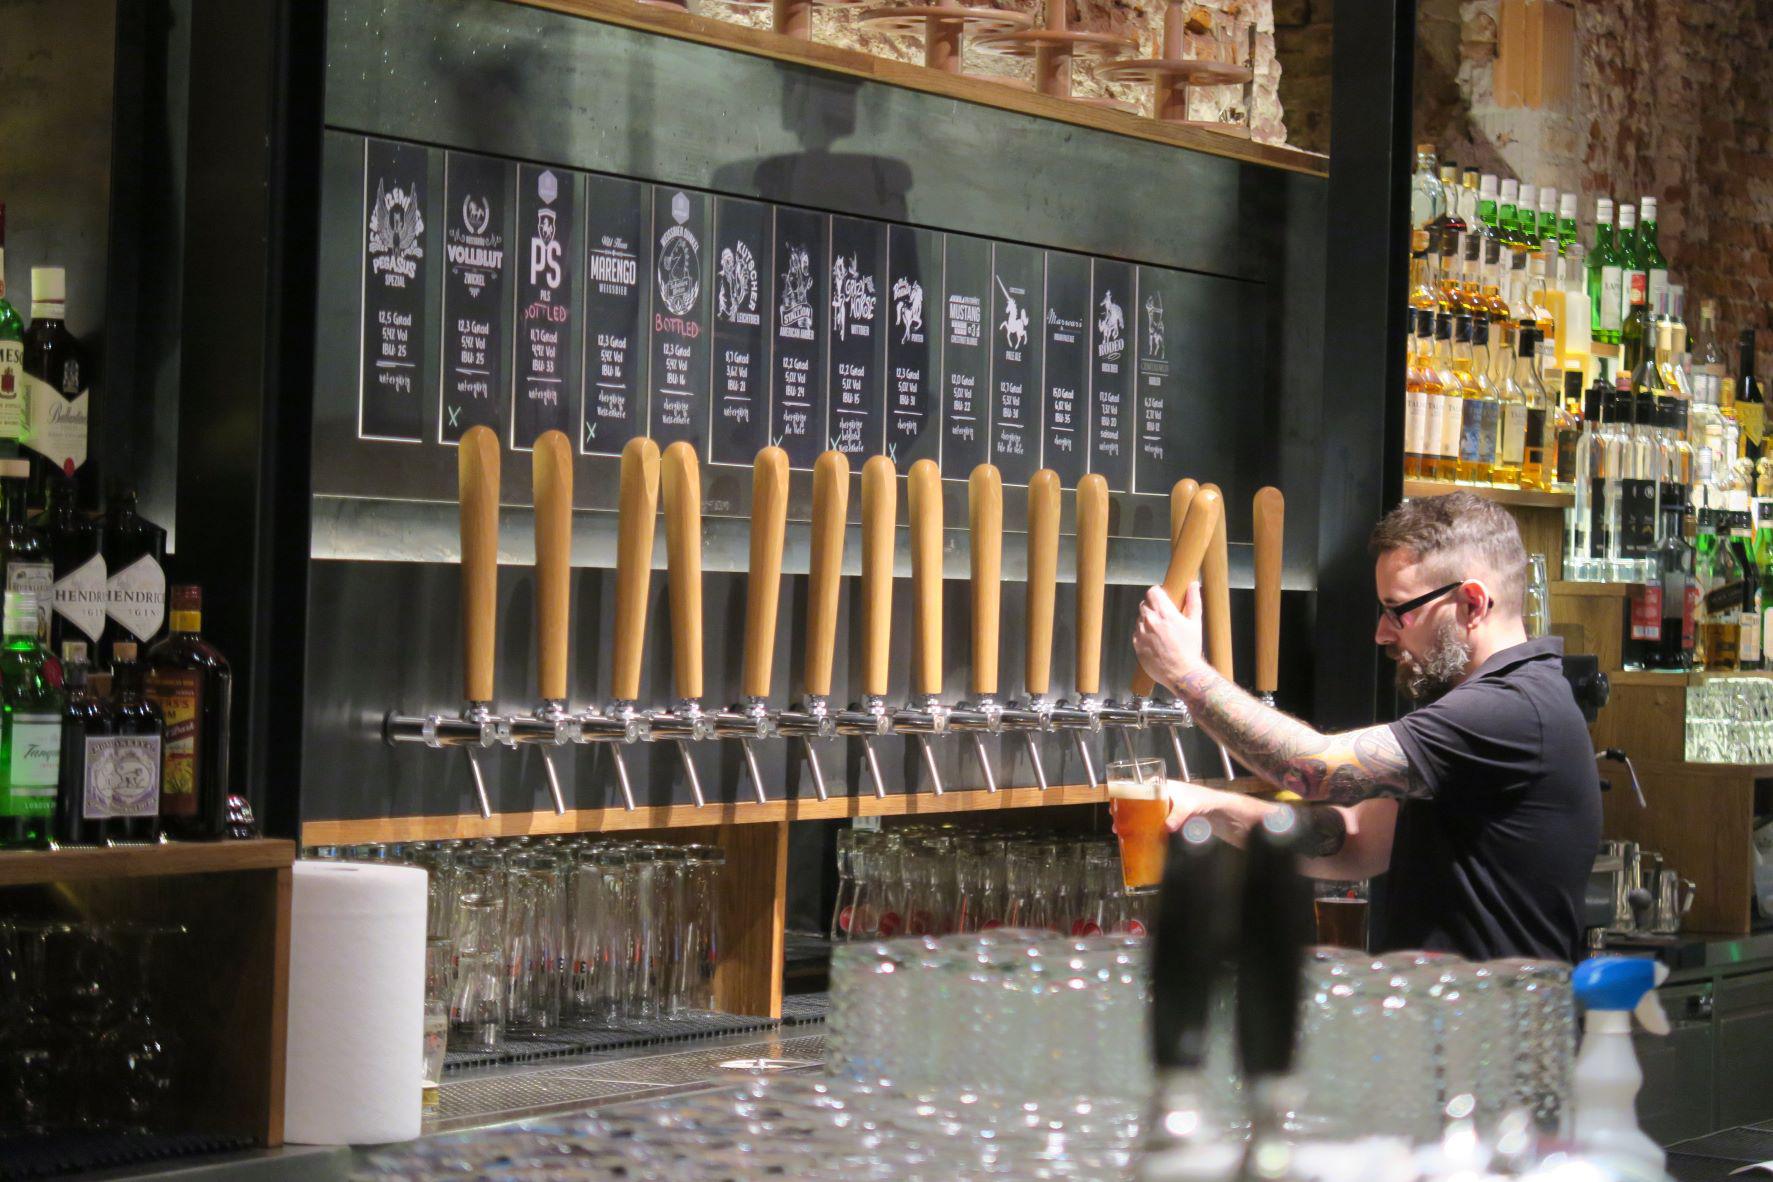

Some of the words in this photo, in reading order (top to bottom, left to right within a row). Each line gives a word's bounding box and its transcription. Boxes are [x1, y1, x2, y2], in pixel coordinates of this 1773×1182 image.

[447, 244, 503, 269] VOLLBLUT
[530, 237, 562, 288] PS
[373, 256, 416, 279] PEGASUS
[591, 255, 636, 285] MARENGO
[385, 274, 405, 288] SPEZIAL
[464, 272, 485, 287] ZWICKEL
[736, 240, 758, 312] KUTSCHER
[540, 290, 551, 301] PILS
[599, 283, 628, 296] WEISSBIER
[950, 302, 981, 322] MUSTANG
[655, 313, 699, 337] BOTTLED
[397, 329, 408, 342] Vol
[475, 338, 486, 350] Vol
[1099, 338, 1124, 356] RODEO
[546, 346, 556, 358] Vol
[613, 351, 623, 363] Vol
[678, 360, 688, 371] Vol
